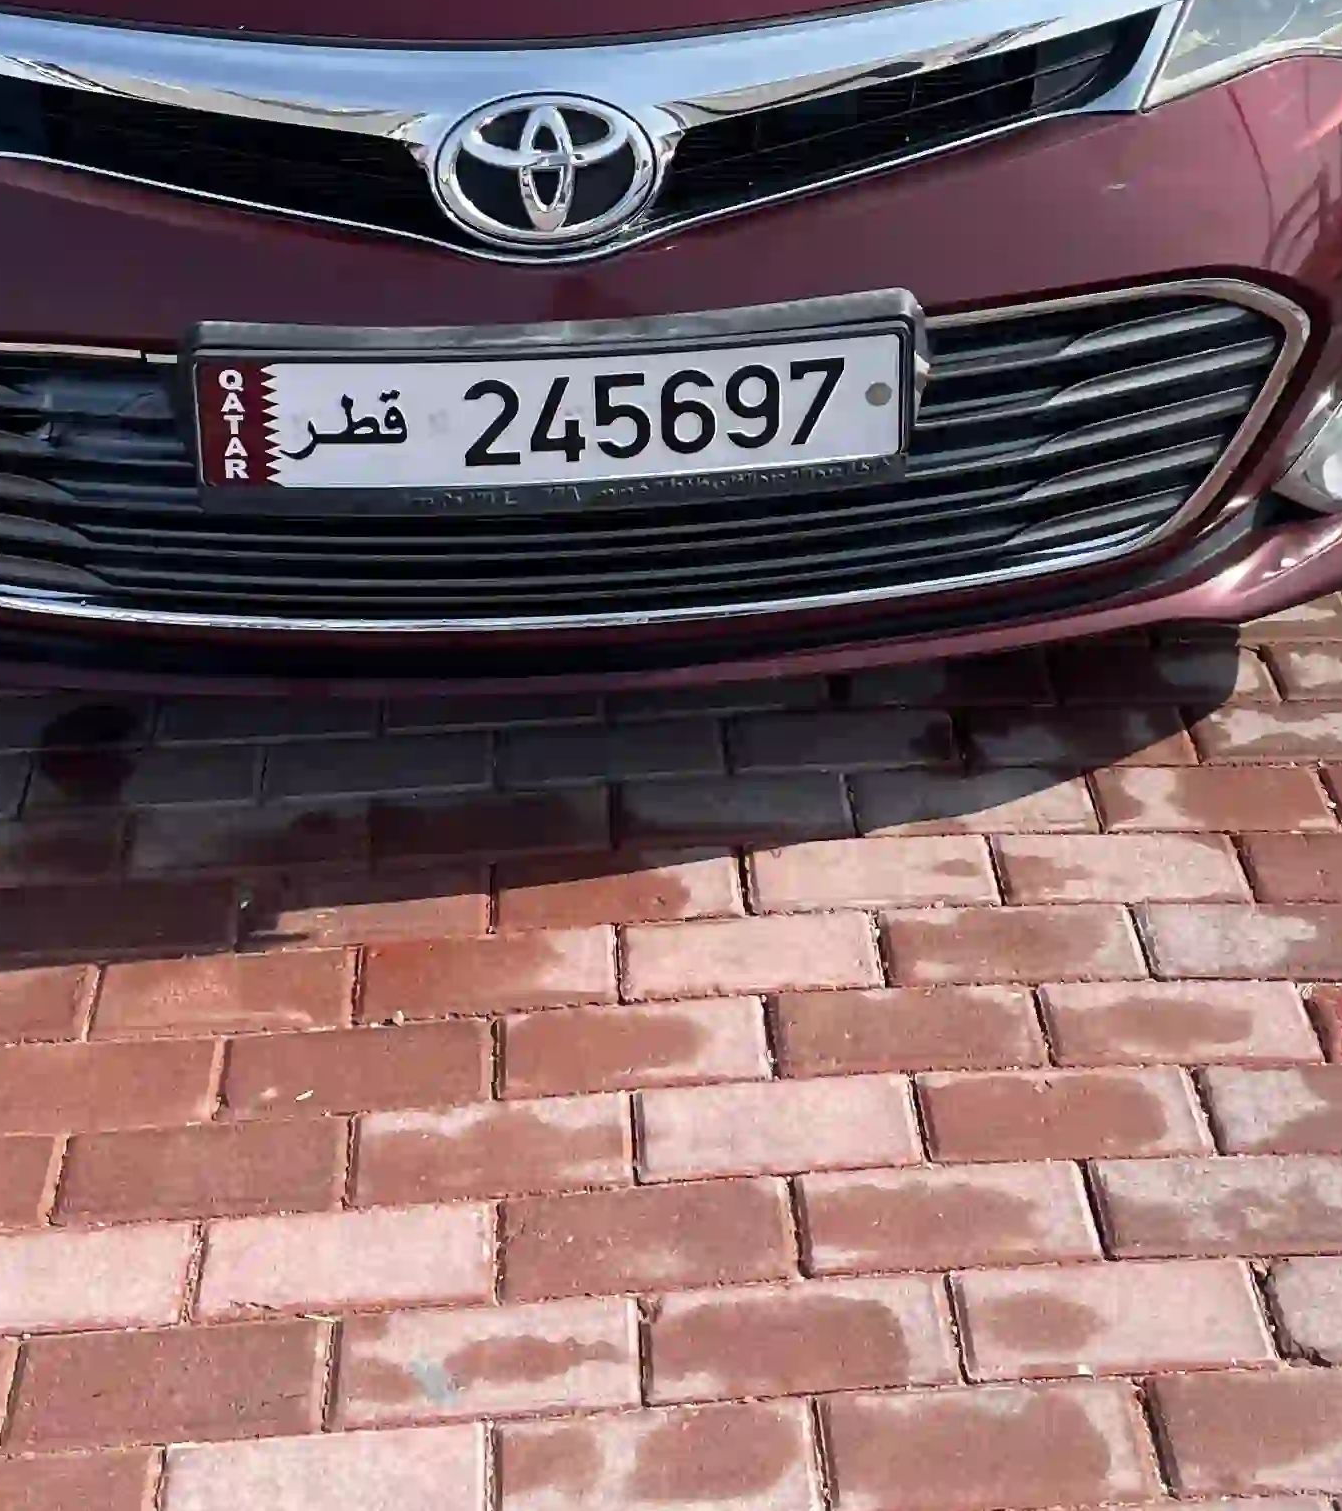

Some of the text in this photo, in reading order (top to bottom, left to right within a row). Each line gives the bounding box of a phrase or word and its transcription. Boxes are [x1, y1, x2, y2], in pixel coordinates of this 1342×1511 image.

[217, 368, 249, 480] QATAR
[279, 391, 409, 460] قطر
[463, 357, 846, 468] 245697
